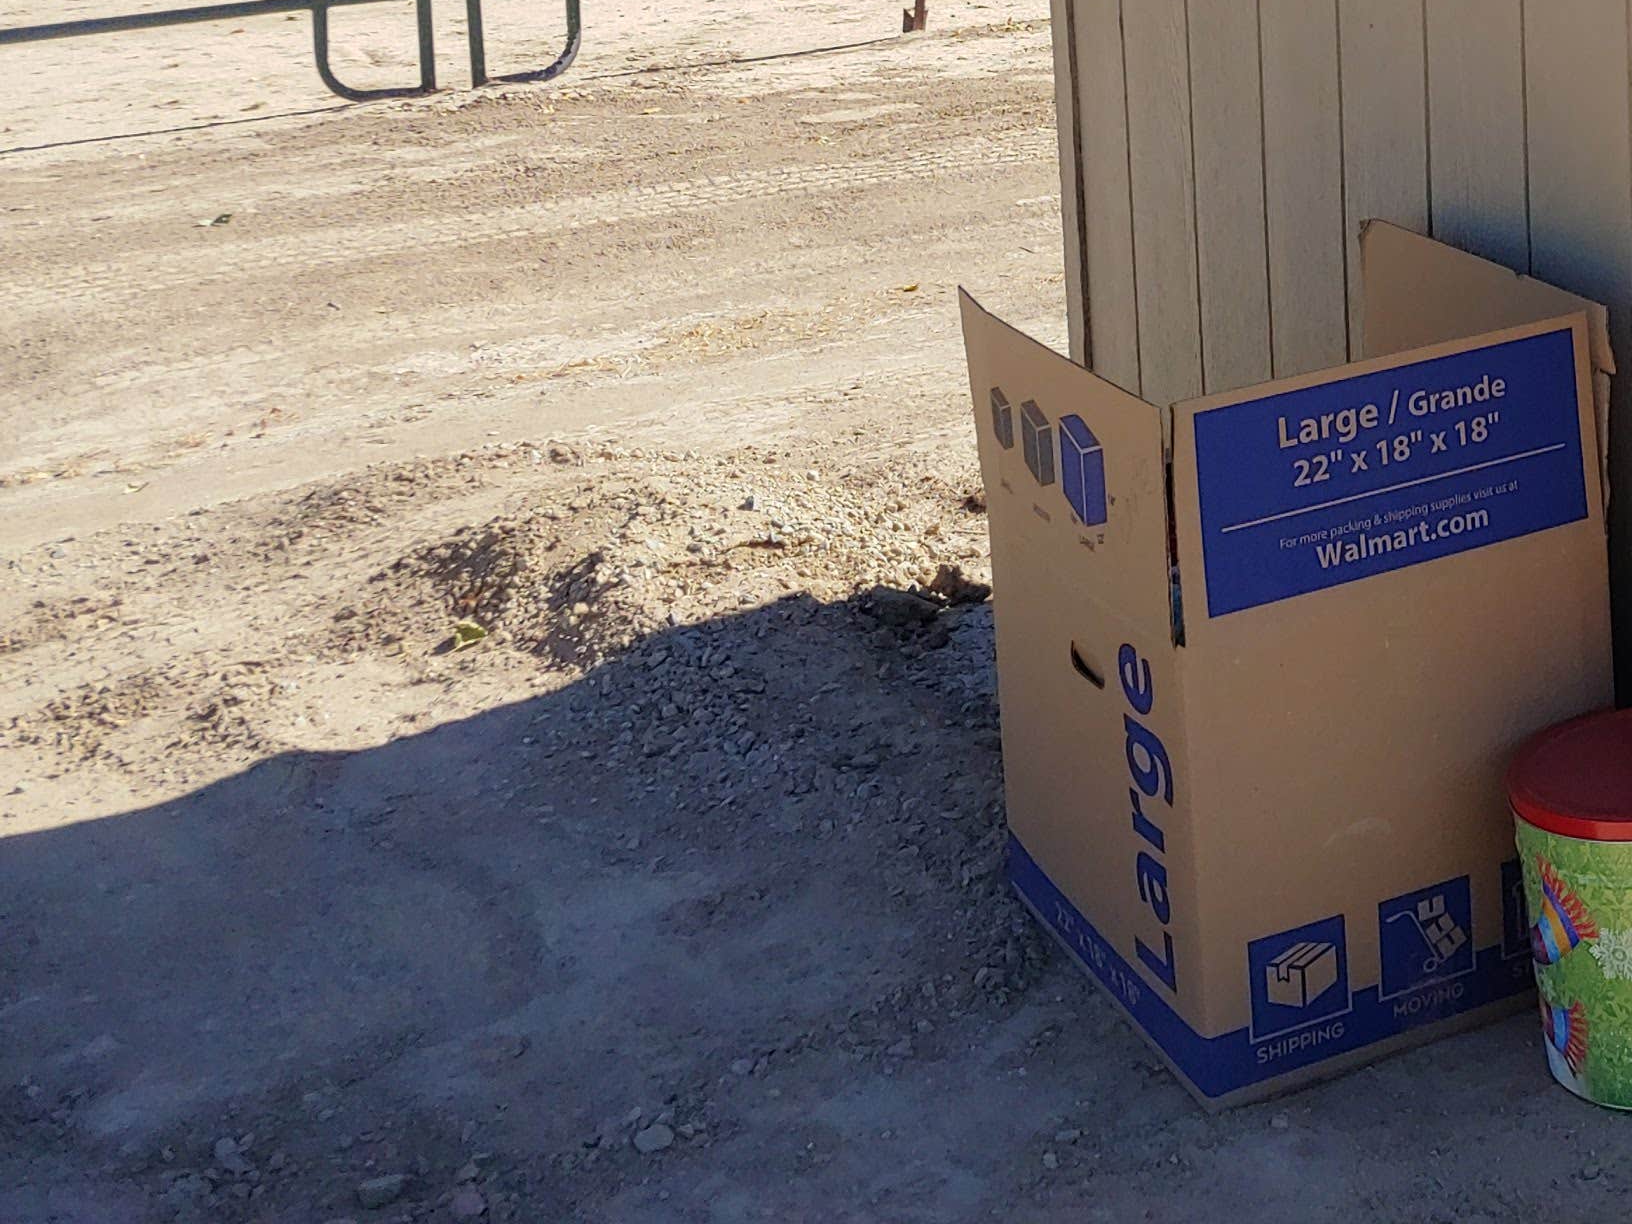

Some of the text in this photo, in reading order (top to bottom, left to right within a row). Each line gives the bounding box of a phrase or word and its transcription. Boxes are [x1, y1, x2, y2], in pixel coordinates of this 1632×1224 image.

[1277, 374, 1507, 450] Large / Grande
[1293, 411, 1500, 488] 22" x 18" x 18"
[1279, 480, 1519, 551] For more packing & shipping supplies visit us at
[1315, 508, 1490, 570] Walmart.com
[1118, 642, 1178, 995] Large
[1392, 982, 1465, 1019] MOVING
[1255, 1021, 1346, 1065] SHIPPING
